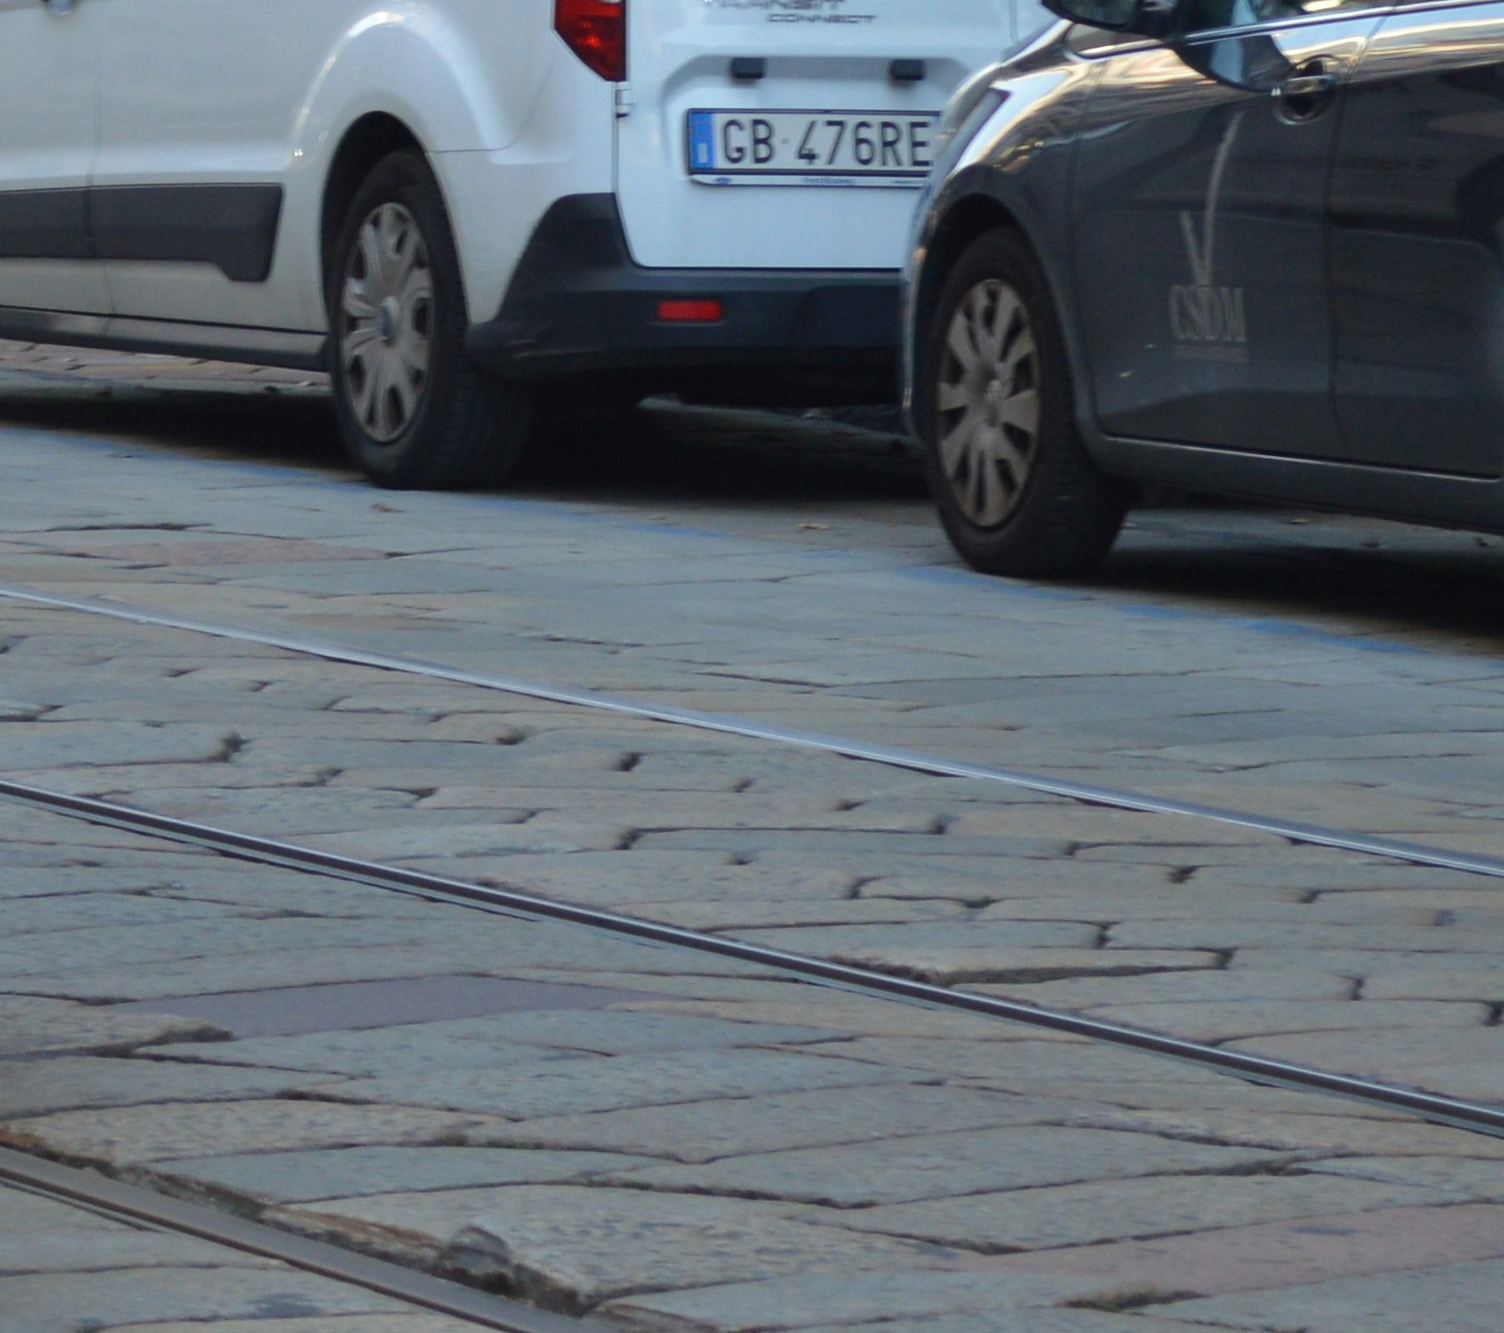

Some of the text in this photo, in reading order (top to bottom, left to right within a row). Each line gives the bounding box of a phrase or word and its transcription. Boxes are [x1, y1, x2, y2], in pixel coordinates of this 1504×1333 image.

[766, 13, 877, 24] CONNECT
[723, 118, 934, 168] GB 476RE
